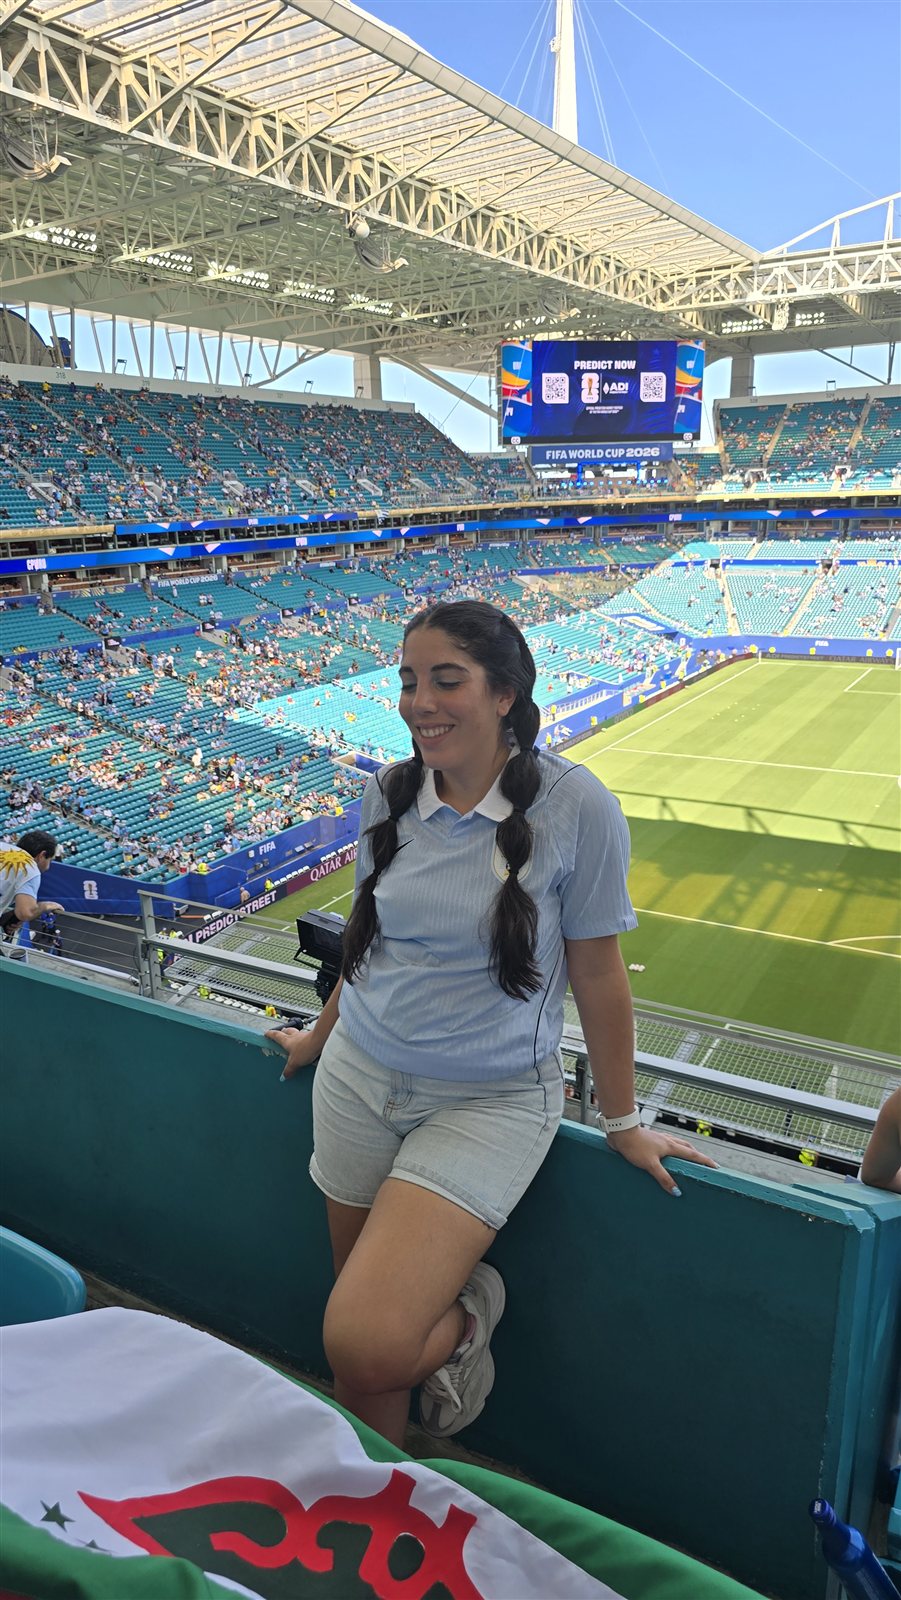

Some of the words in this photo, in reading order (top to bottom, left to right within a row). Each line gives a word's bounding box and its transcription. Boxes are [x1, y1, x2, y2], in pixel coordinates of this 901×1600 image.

[574, 360, 613, 370] PREDICT
[614, 360, 636, 370] NOW
[610, 382, 629, 391] ADI
[545, 450, 567, 460] FIFA
[568, 449, 604, 459] WORLD
[605, 448, 625, 458] CUP
[625, 447, 660, 457] 2026
[170, 578, 190, 586] WORLD
[200, 574, 218, 583] 2026
[259, 841, 276, 855] FIFA
[310, 857, 342, 881] QATAR
